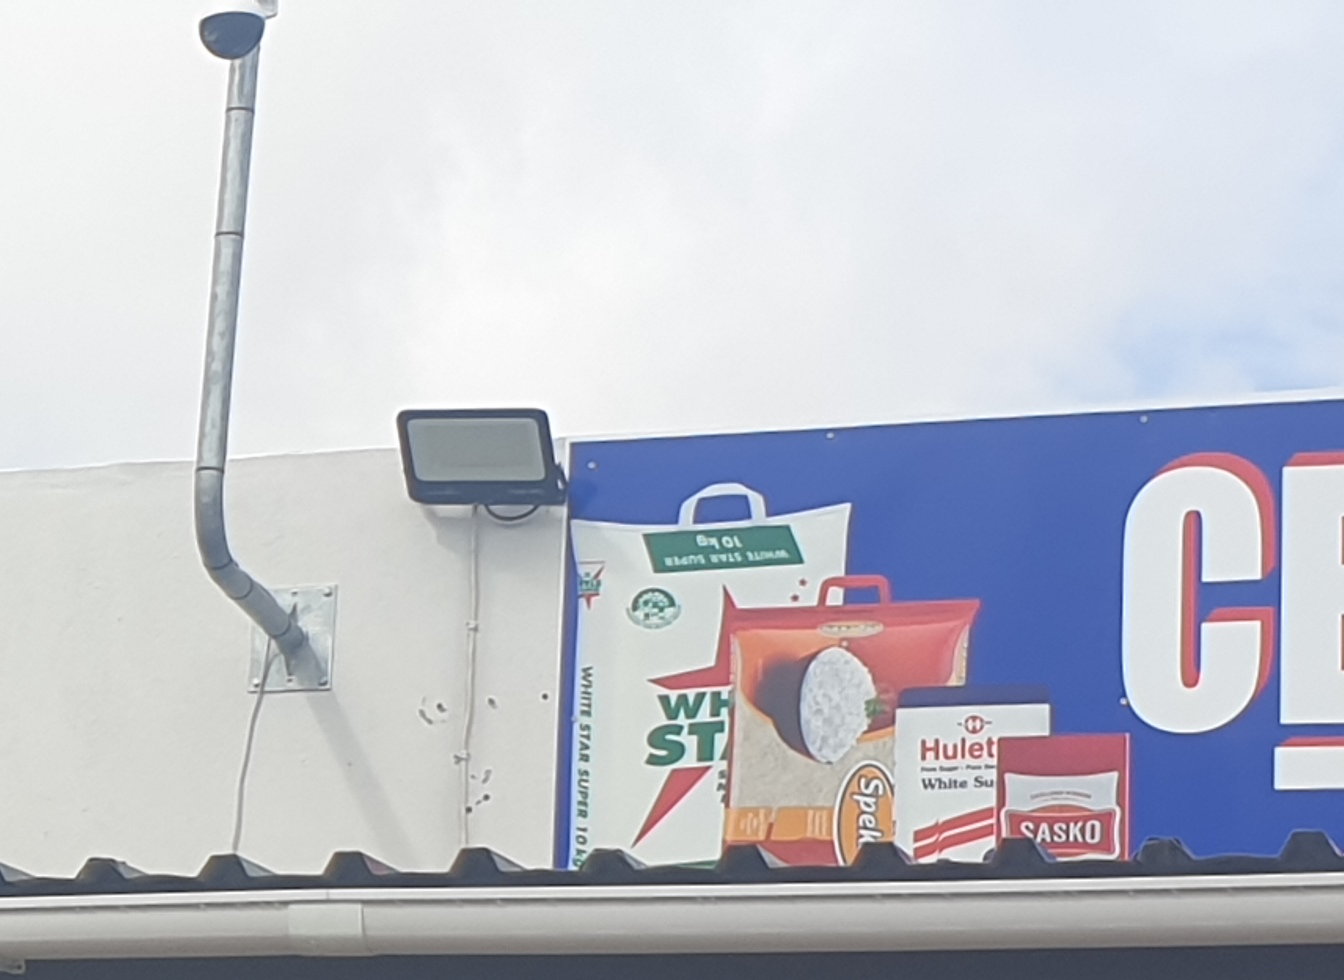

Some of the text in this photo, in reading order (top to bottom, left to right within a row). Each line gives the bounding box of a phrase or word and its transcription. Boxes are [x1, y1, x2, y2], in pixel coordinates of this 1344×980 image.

[664, 554, 706, 566] SUPER
[710, 551, 743, 563] STAR
[579, 666, 594, 718] WHITE
[578, 722, 592, 763] STAR
[576, 768, 591, 819] SUPER
[921, 777, 968, 791] White
[1019, 819, 1102, 844] SASKO
